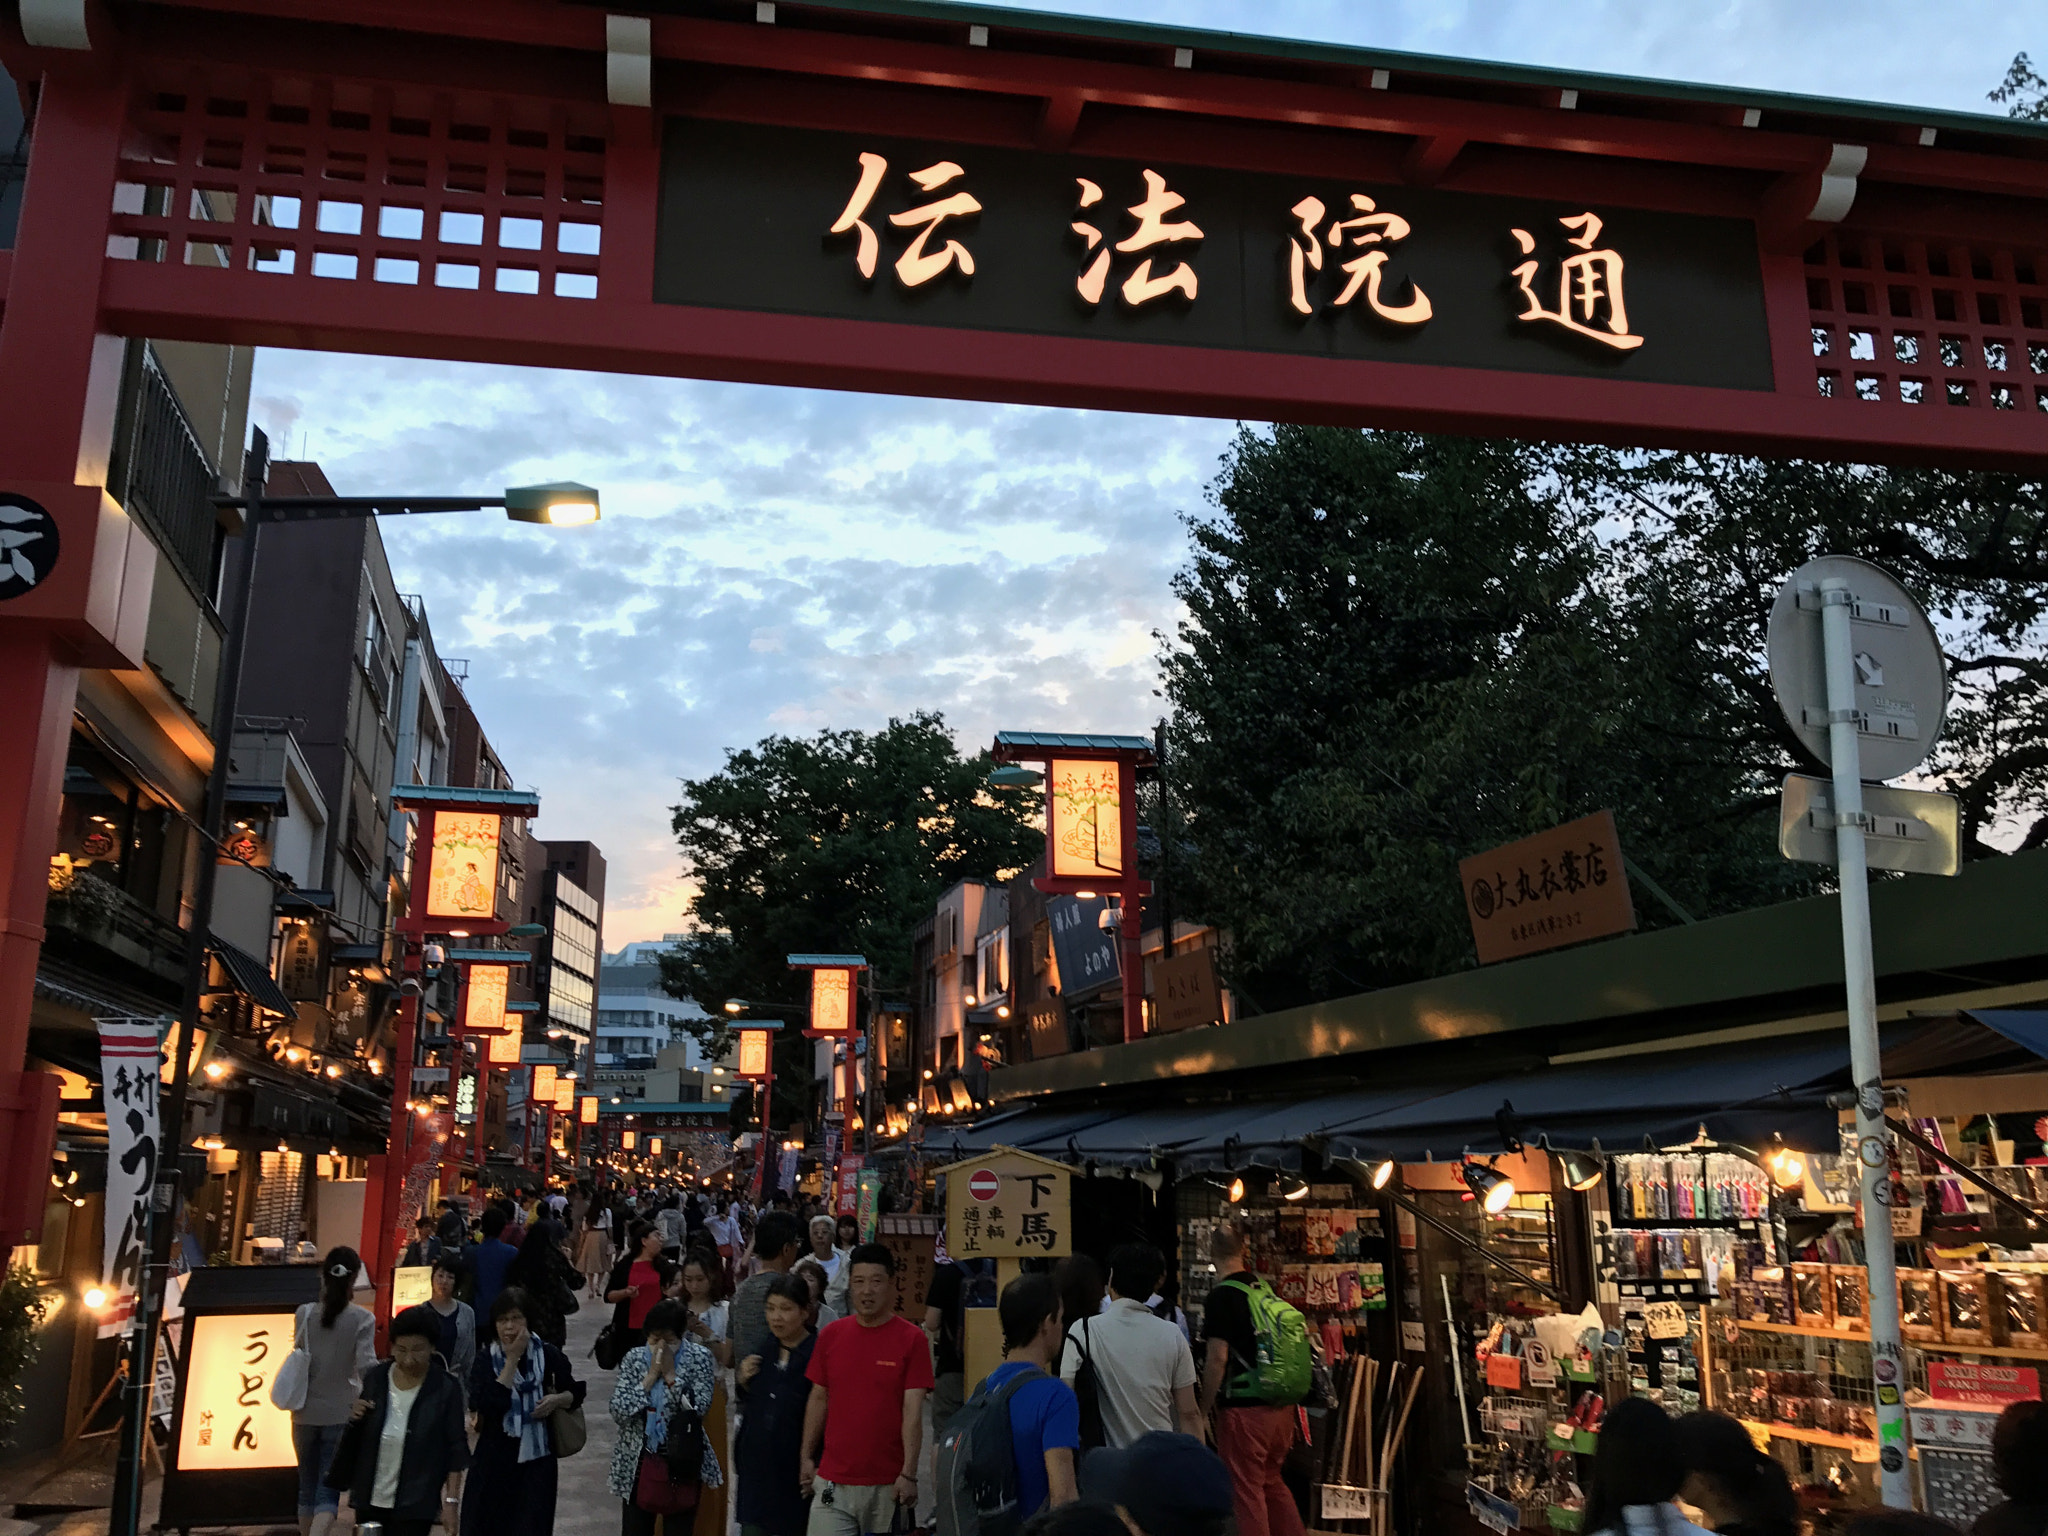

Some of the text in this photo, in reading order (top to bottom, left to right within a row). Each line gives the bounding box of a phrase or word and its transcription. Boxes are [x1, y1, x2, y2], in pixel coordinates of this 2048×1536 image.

[829, 151, 1645, 350] 伝法院通
[1494, 842, 1608, 910] 大丸衣裳店
[962, 1206, 981, 1252] 通行止
[1015, 1173, 1058, 1251] 下馬
[232, 1329, 270, 1451] うどん
[1943, 1365, 2019, 1383] NAME STAMP
[1947, 1379, 1980, 1391] KANJI
